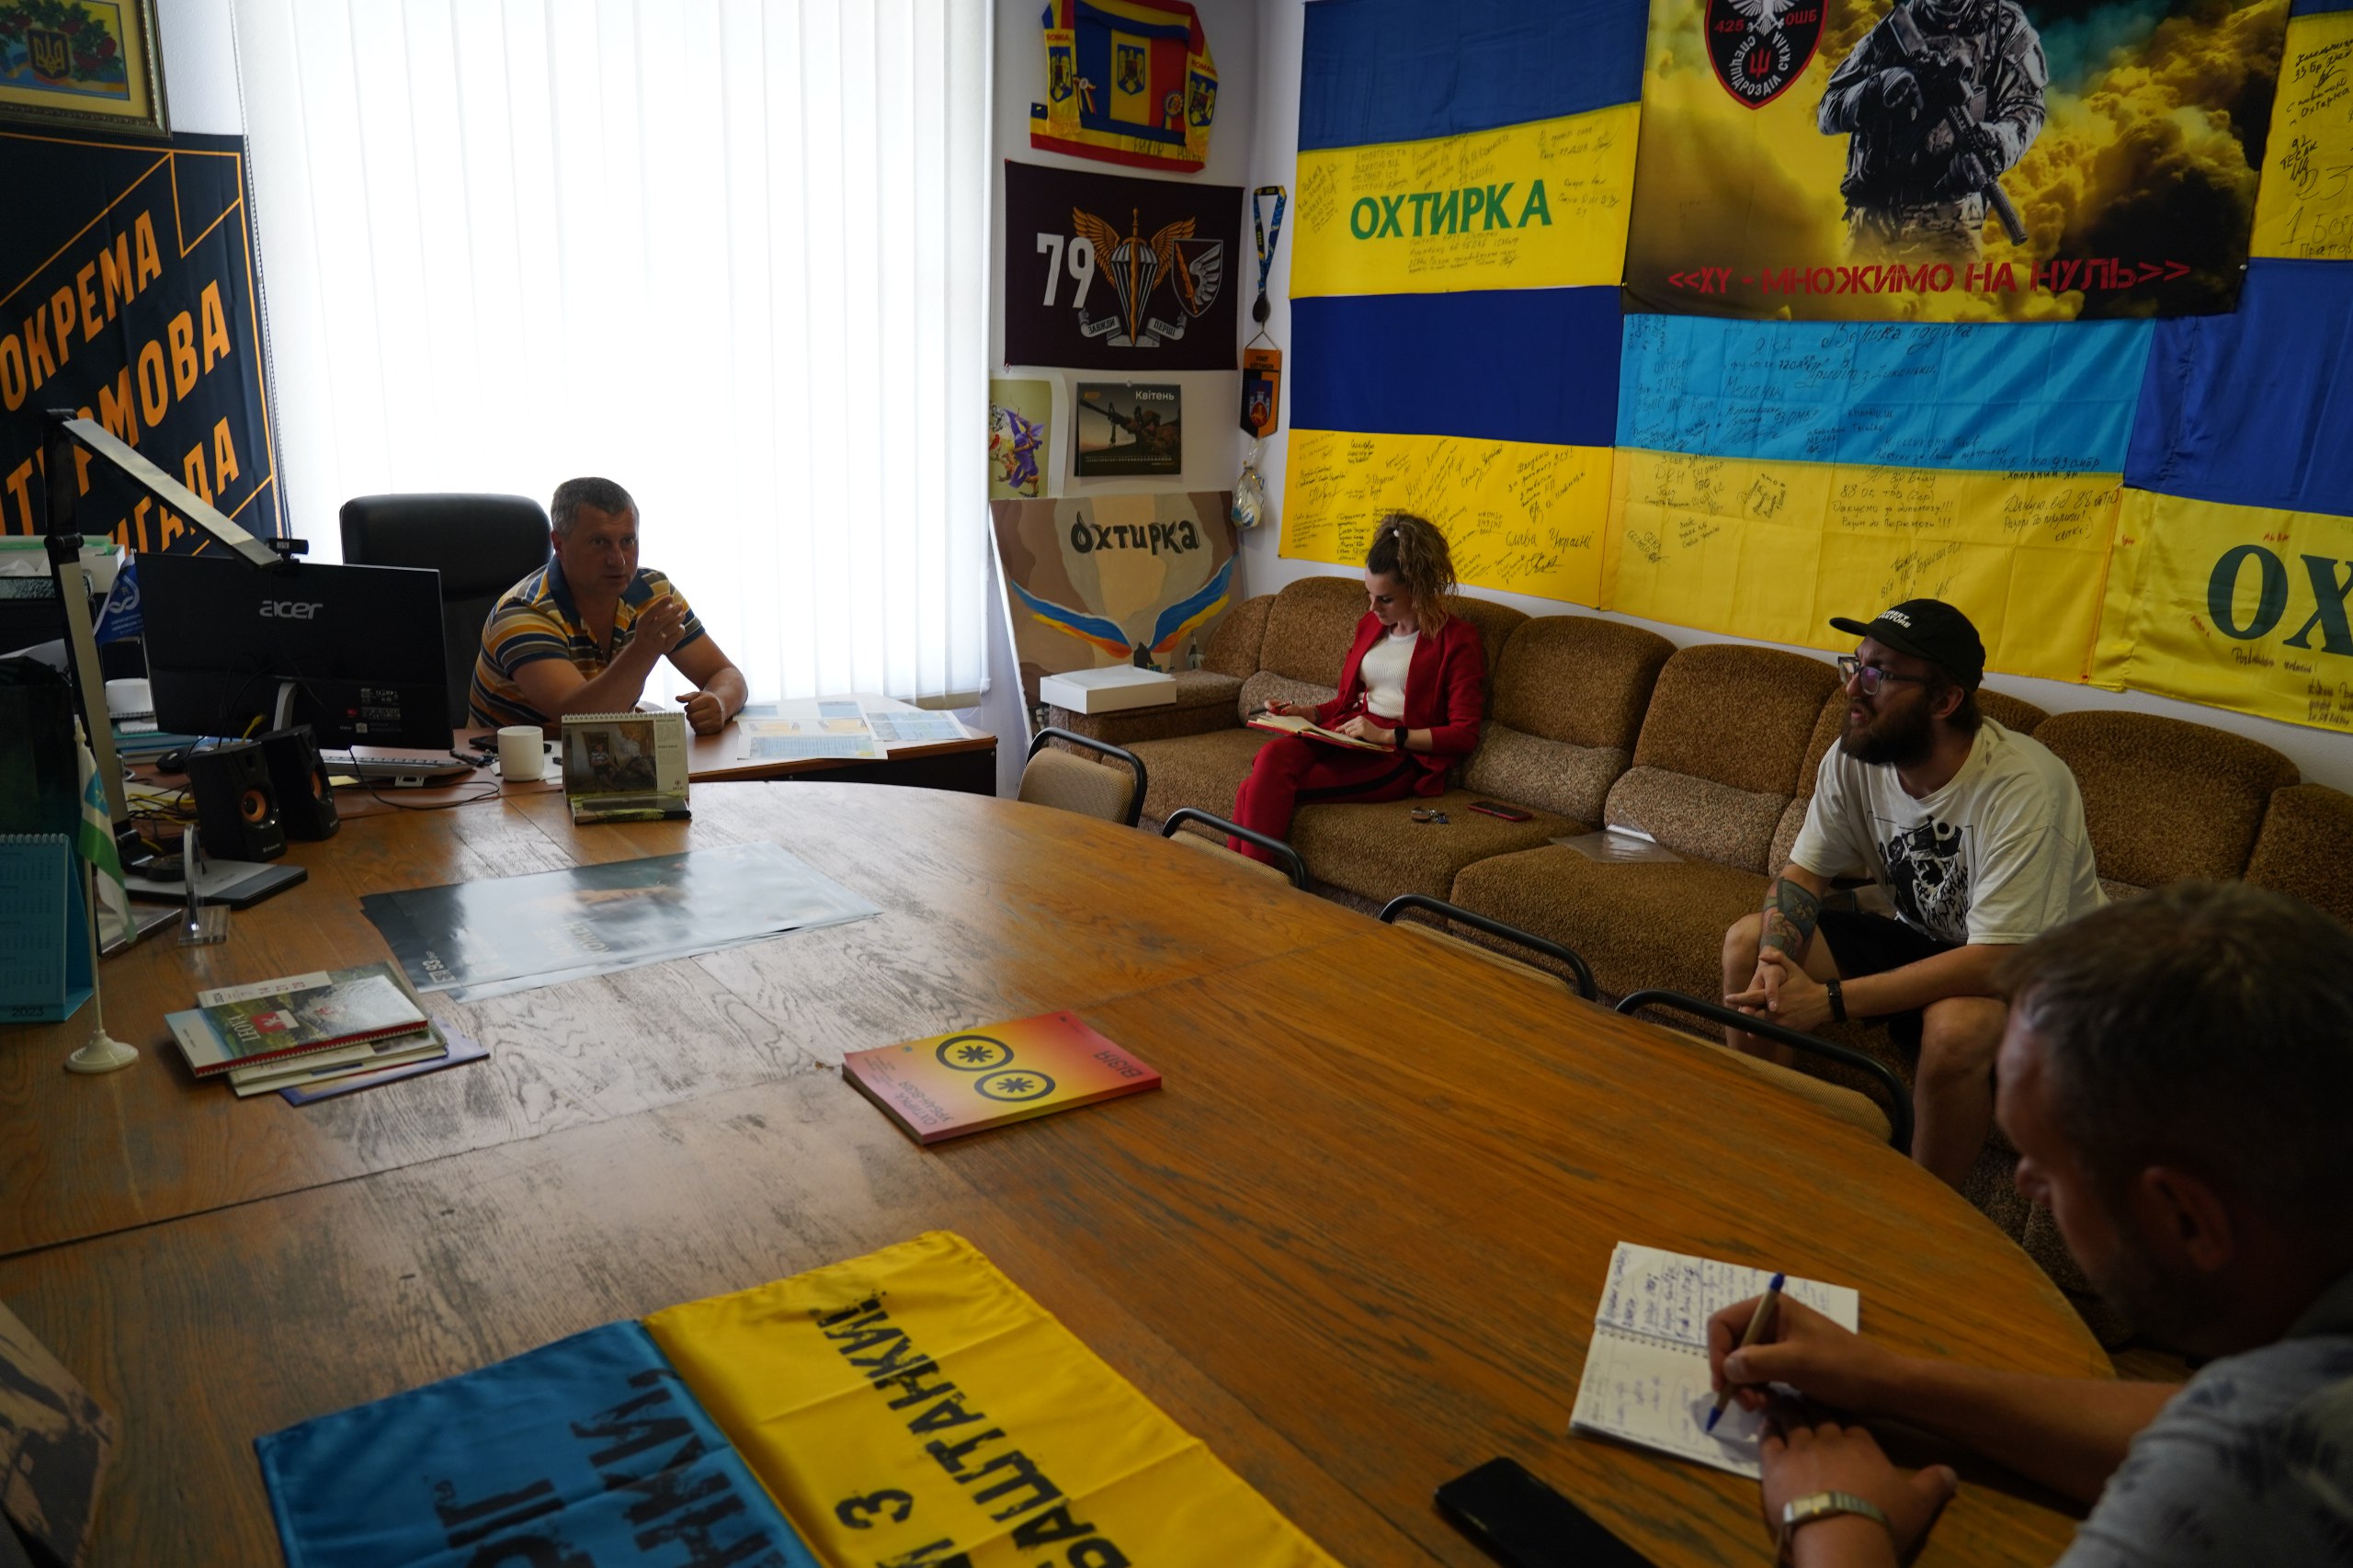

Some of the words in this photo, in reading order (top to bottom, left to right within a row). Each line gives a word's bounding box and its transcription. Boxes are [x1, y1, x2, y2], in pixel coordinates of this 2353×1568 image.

[1714, 18, 1745, 33] 425
[1785, 8, 1817, 27] ОШБ
[1350, 178, 1554, 241] ОХТИРКА
[1036, 231, 1096, 309] 79
[1761, 263, 1955, 296] МНОЖИМО
[1965, 262, 2017, 293] НА
[0, 210, 163, 413] ОКРЕМА
[1087, 317, 1116, 335] ЗАВЖДИ
[1154, 320, 1176, 336] ПЕРШІ
[1135, 390, 1175, 401] Квітень
[258, 599, 324, 620] acer
[12, 1006, 45, 1017] 2023
[834, 1486, 915, 1530] З
